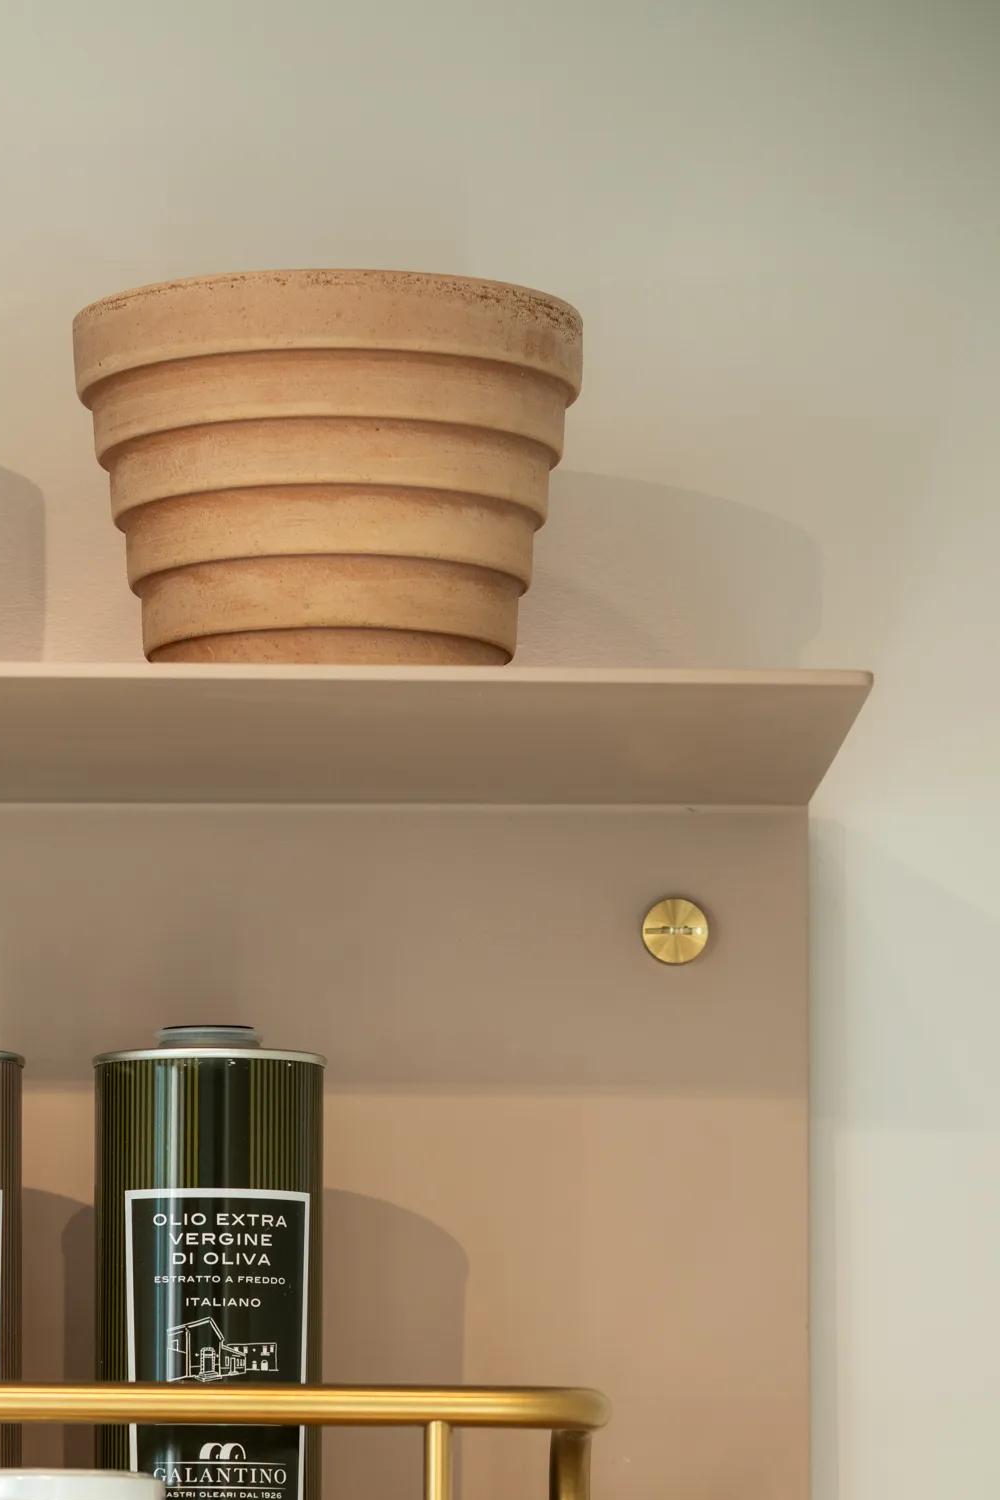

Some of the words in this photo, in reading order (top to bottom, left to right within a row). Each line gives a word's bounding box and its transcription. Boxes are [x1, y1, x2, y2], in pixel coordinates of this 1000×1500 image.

[153, 1213, 207, 1227] OLIO
[216, 1213, 288, 1228] EXTRA
[169, 1232, 273, 1247] VERGINE
[172, 1252, 194, 1265] DI
[203, 1252, 271, 1266] OLIVA
[154, 1275, 221, 1284] ESTRATTO
[225, 1276, 234, 1284] A
[238, 1275, 286, 1285] FREDDO
[186, 1297, 261, 1308] ITALIANO
[153, 1467, 287, 1485] GALANTINO
[166, 1491, 196, 1499] ASTRI
[199, 1491, 236, 1499] OLEARI
[239, 1491, 259, 1499] DAL
[261, 1491, 282, 1499] 1926
